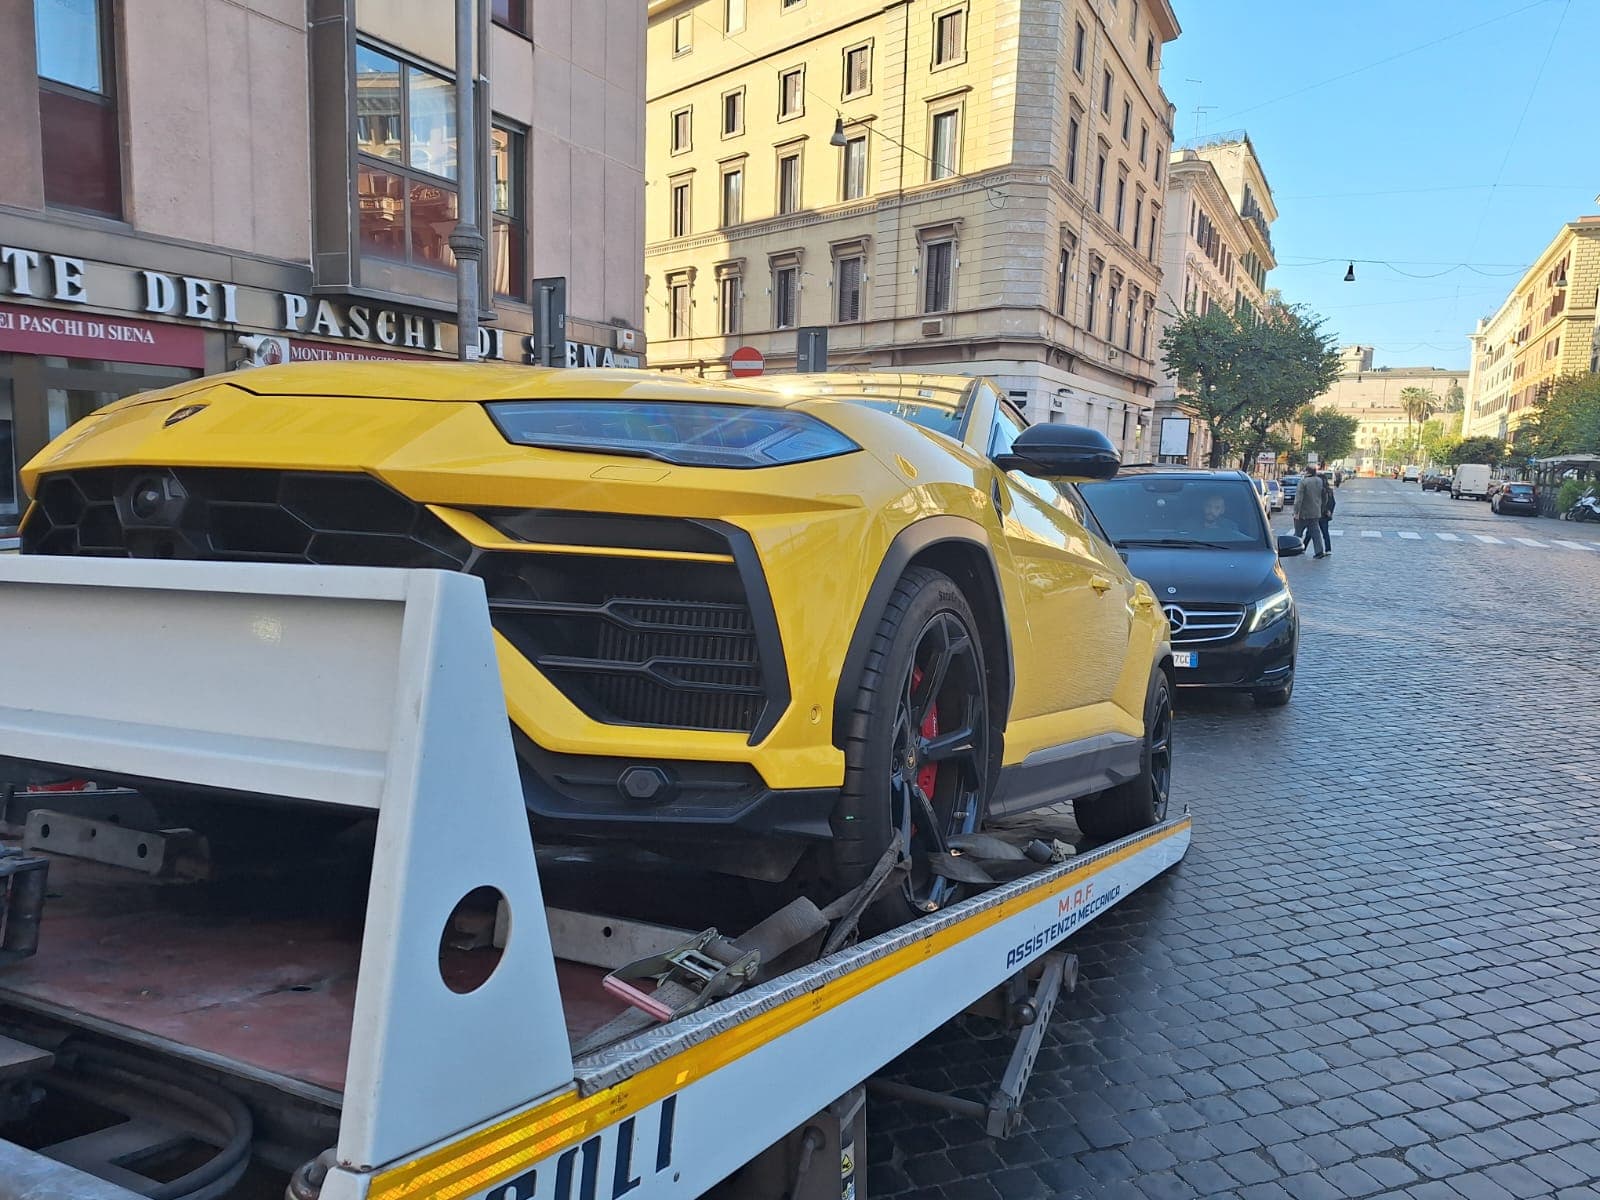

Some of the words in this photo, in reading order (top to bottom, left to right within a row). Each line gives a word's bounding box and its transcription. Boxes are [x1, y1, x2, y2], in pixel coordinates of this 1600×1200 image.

[20, 314, 83, 338] PASCHI
[88, 323, 104, 340] DI
[108, 325, 155, 344] SIENA
[143, 270, 239, 324] DEI
[283, 293, 443, 351] PASCHI
[477, 326, 504, 358] DI
[291, 345, 334, 361] MONTE
[1006, 913, 1078, 970] ASSISTENZA
[1077, 884, 1121, 921] MECCANICA
